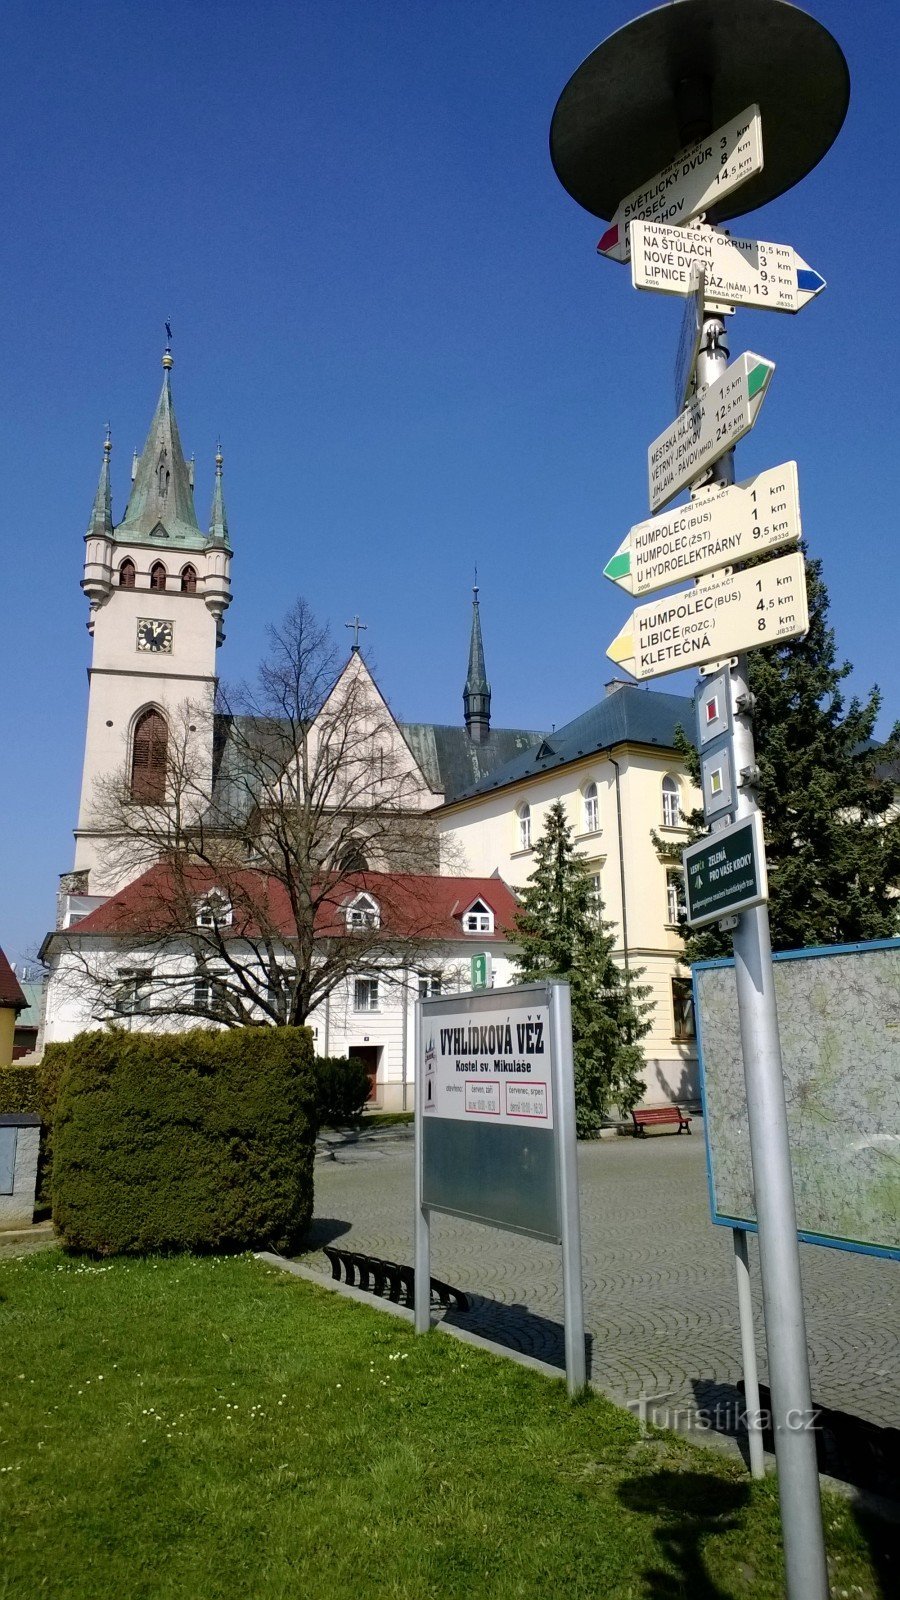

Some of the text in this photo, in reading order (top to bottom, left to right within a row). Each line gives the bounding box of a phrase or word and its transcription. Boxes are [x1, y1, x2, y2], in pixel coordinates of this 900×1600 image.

[720, 152, 728, 165] 8
[737, 141, 751, 154] km
[624, 124, 750, 218] SVĚTLICKÝ DVŮR 3 km
[714, 166, 737, 185] 14,5
[738, 157, 752, 170] km
[643, 224, 790, 258] HUMPOLECKÝ OKRUH 10,5 km
[643, 235, 792, 271] NA ŠTŮLÁCH 3 km
[644, 250, 675, 266] NOVÉ
[760, 270, 776, 283] 9,5
[778, 276, 792, 286] km
[644, 265, 687, 283] LIPNICE
[753, 283, 769, 296] 13
[779, 291, 793, 301] km
[709, 289, 730, 298] TRASA
[651, 376, 742, 467] MĚSTSKÁ HÁJOVNA 1,5 km
[651, 394, 743, 482] VĚTRNÝ JENÍKOV 12,5 km
[652, 471, 675, 499] JIHLAVA
[716, 422, 733, 442] 24,5
[733, 413, 744, 427] km
[695, 496, 716, 508] TRASA
[716, 490, 730, 500] KČT
[750, 490, 757, 502] 1
[769, 484, 786, 496] km
[751, 508, 758, 520] 1
[771, 502, 787, 514] km
[637, 521, 789, 583] U HYDROELEKTRÁRNY 9,5 km
[637, 582, 651, 592] 2006
[699, 583, 720, 594] TRASA
[721, 577, 735, 587] KČT
[755, 579, 762, 592] 1
[776, 575, 793, 587] km
[756, 598, 775, 611] 4,5
[777, 595, 794, 606] km
[640, 614, 795, 667] KLETEČNÁ 8 km
[641, 667, 655, 676] 2006
[708, 846, 727, 867] ZELENÁ
[709, 853, 752, 882] PRO VAŠE KROKY
[440, 1014, 545, 1056] VYHLÍDKOVÁ VĚŽ
[455, 1059, 532, 1073] Kostel sv. Mikuláše
